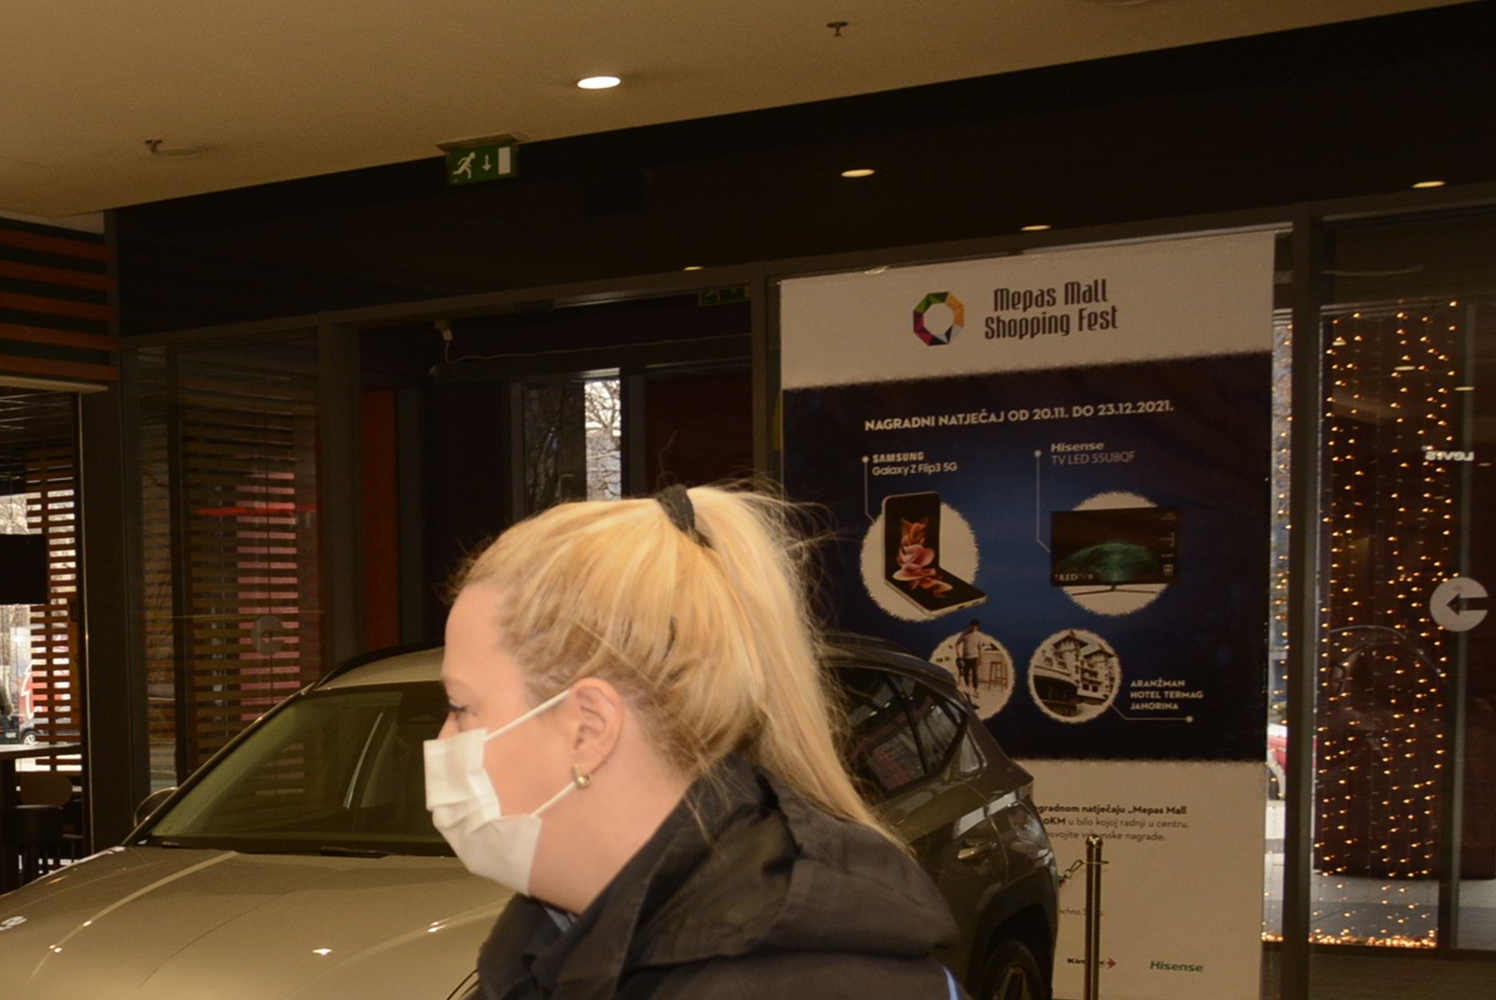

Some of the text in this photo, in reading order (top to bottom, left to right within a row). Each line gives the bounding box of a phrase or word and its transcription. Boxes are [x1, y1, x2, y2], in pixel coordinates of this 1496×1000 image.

[993, 278, 1109, 312] Mepas Mall
[984, 305, 1118, 340] Shopping Fest
[864, 399, 1175, 431] NAGRADNI NATJEČAJ OD 20.11. DO 23.12.2021.
[1050, 442, 1105, 453] Hisense
[871, 451, 925, 464] SAMSUNG
[1050, 455, 1067, 466] TV
[1067, 453, 1090, 465] LED
[871, 465, 910, 477] Galaxy
[909, 463, 917, 474] Z
[942, 461, 958, 472] 5G
[1129, 677, 1186, 688] ARANŽMAN
[1129, 689, 1204, 699] HOTEL TERMAG
[1129, 702, 1180, 711] JAHORINA
[1081, 803, 1126, 816] natječaju
[1165, 805, 1187, 815] Mall
[1076, 816, 1094, 827] bilo
[1095, 816, 1118, 829] kojoj
[1120, 816, 1146, 829] radnji
[1149, 960, 1204, 973] Hisense
